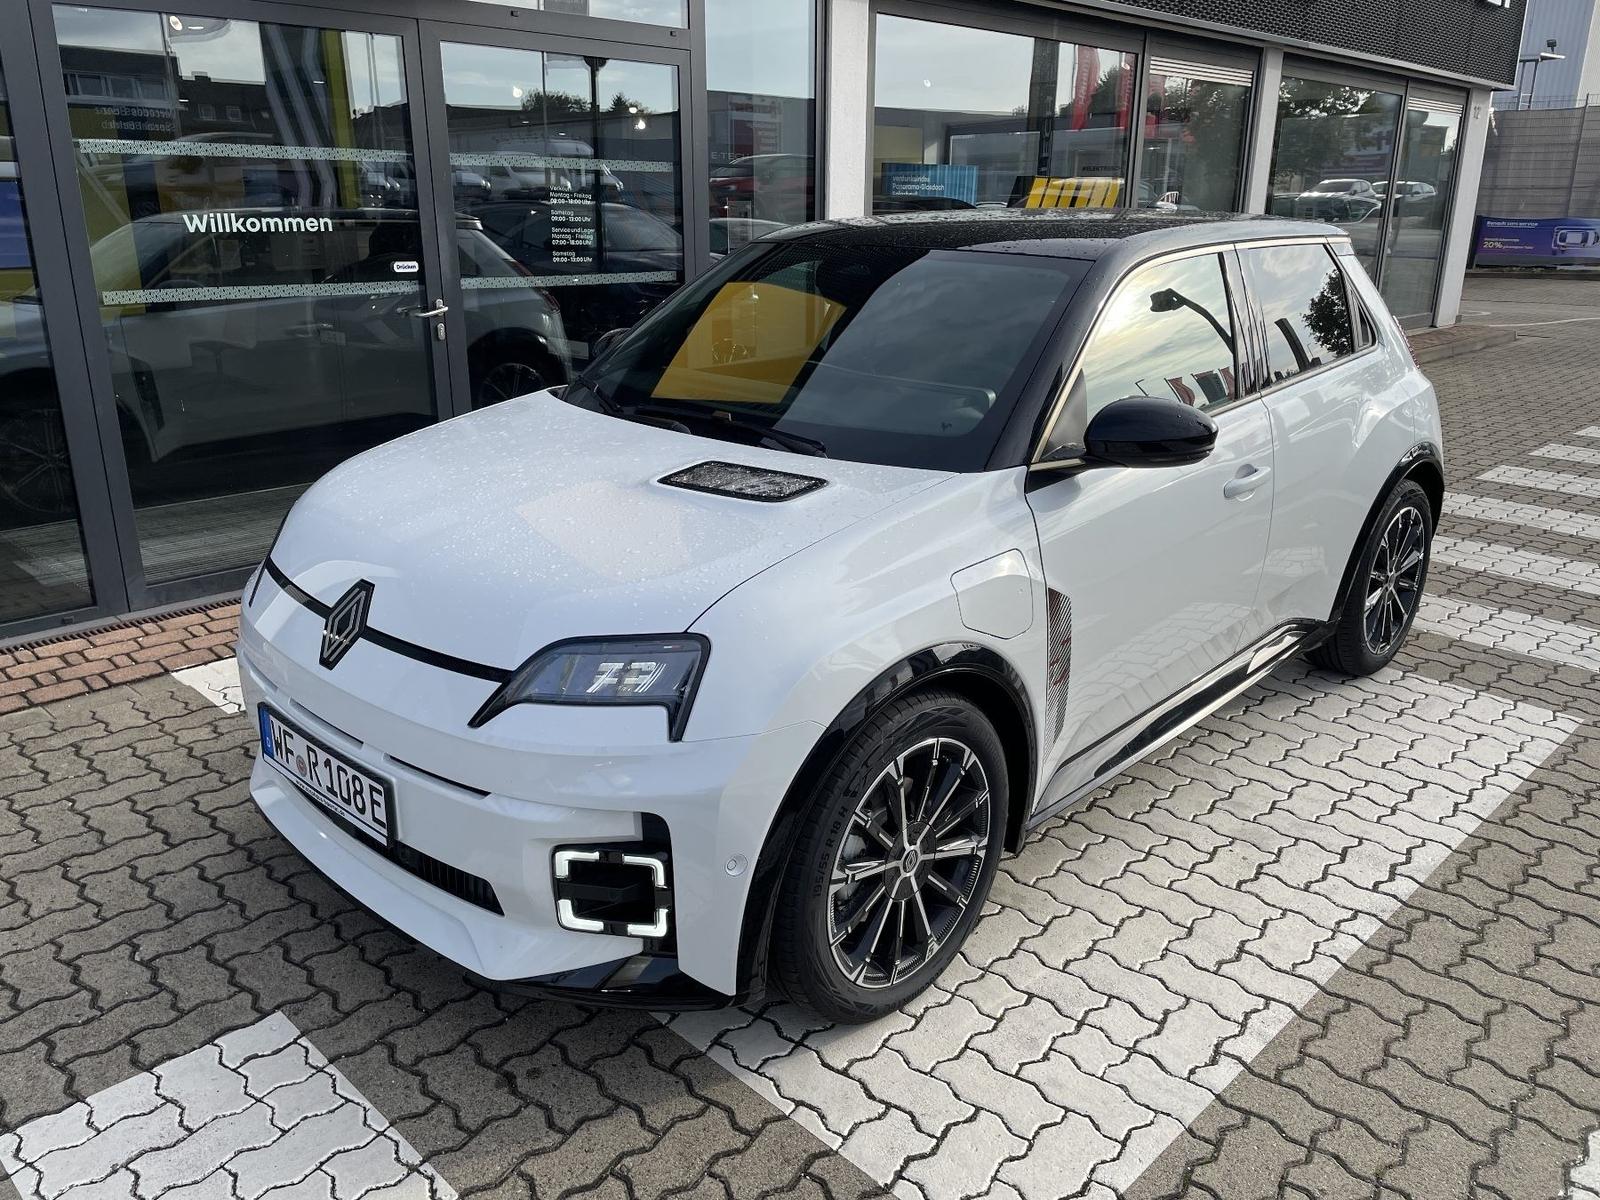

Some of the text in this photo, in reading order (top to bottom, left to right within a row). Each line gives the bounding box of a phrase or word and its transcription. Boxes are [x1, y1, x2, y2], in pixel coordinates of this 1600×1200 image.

[892, 183, 945, 191] Panorama-Glasdach
[183, 212, 333, 233] Willkommen
[1483, 241, 1504, 249] 20%
[271, 718, 294, 765] WF
[813, 853, 830, 897] 195/55
